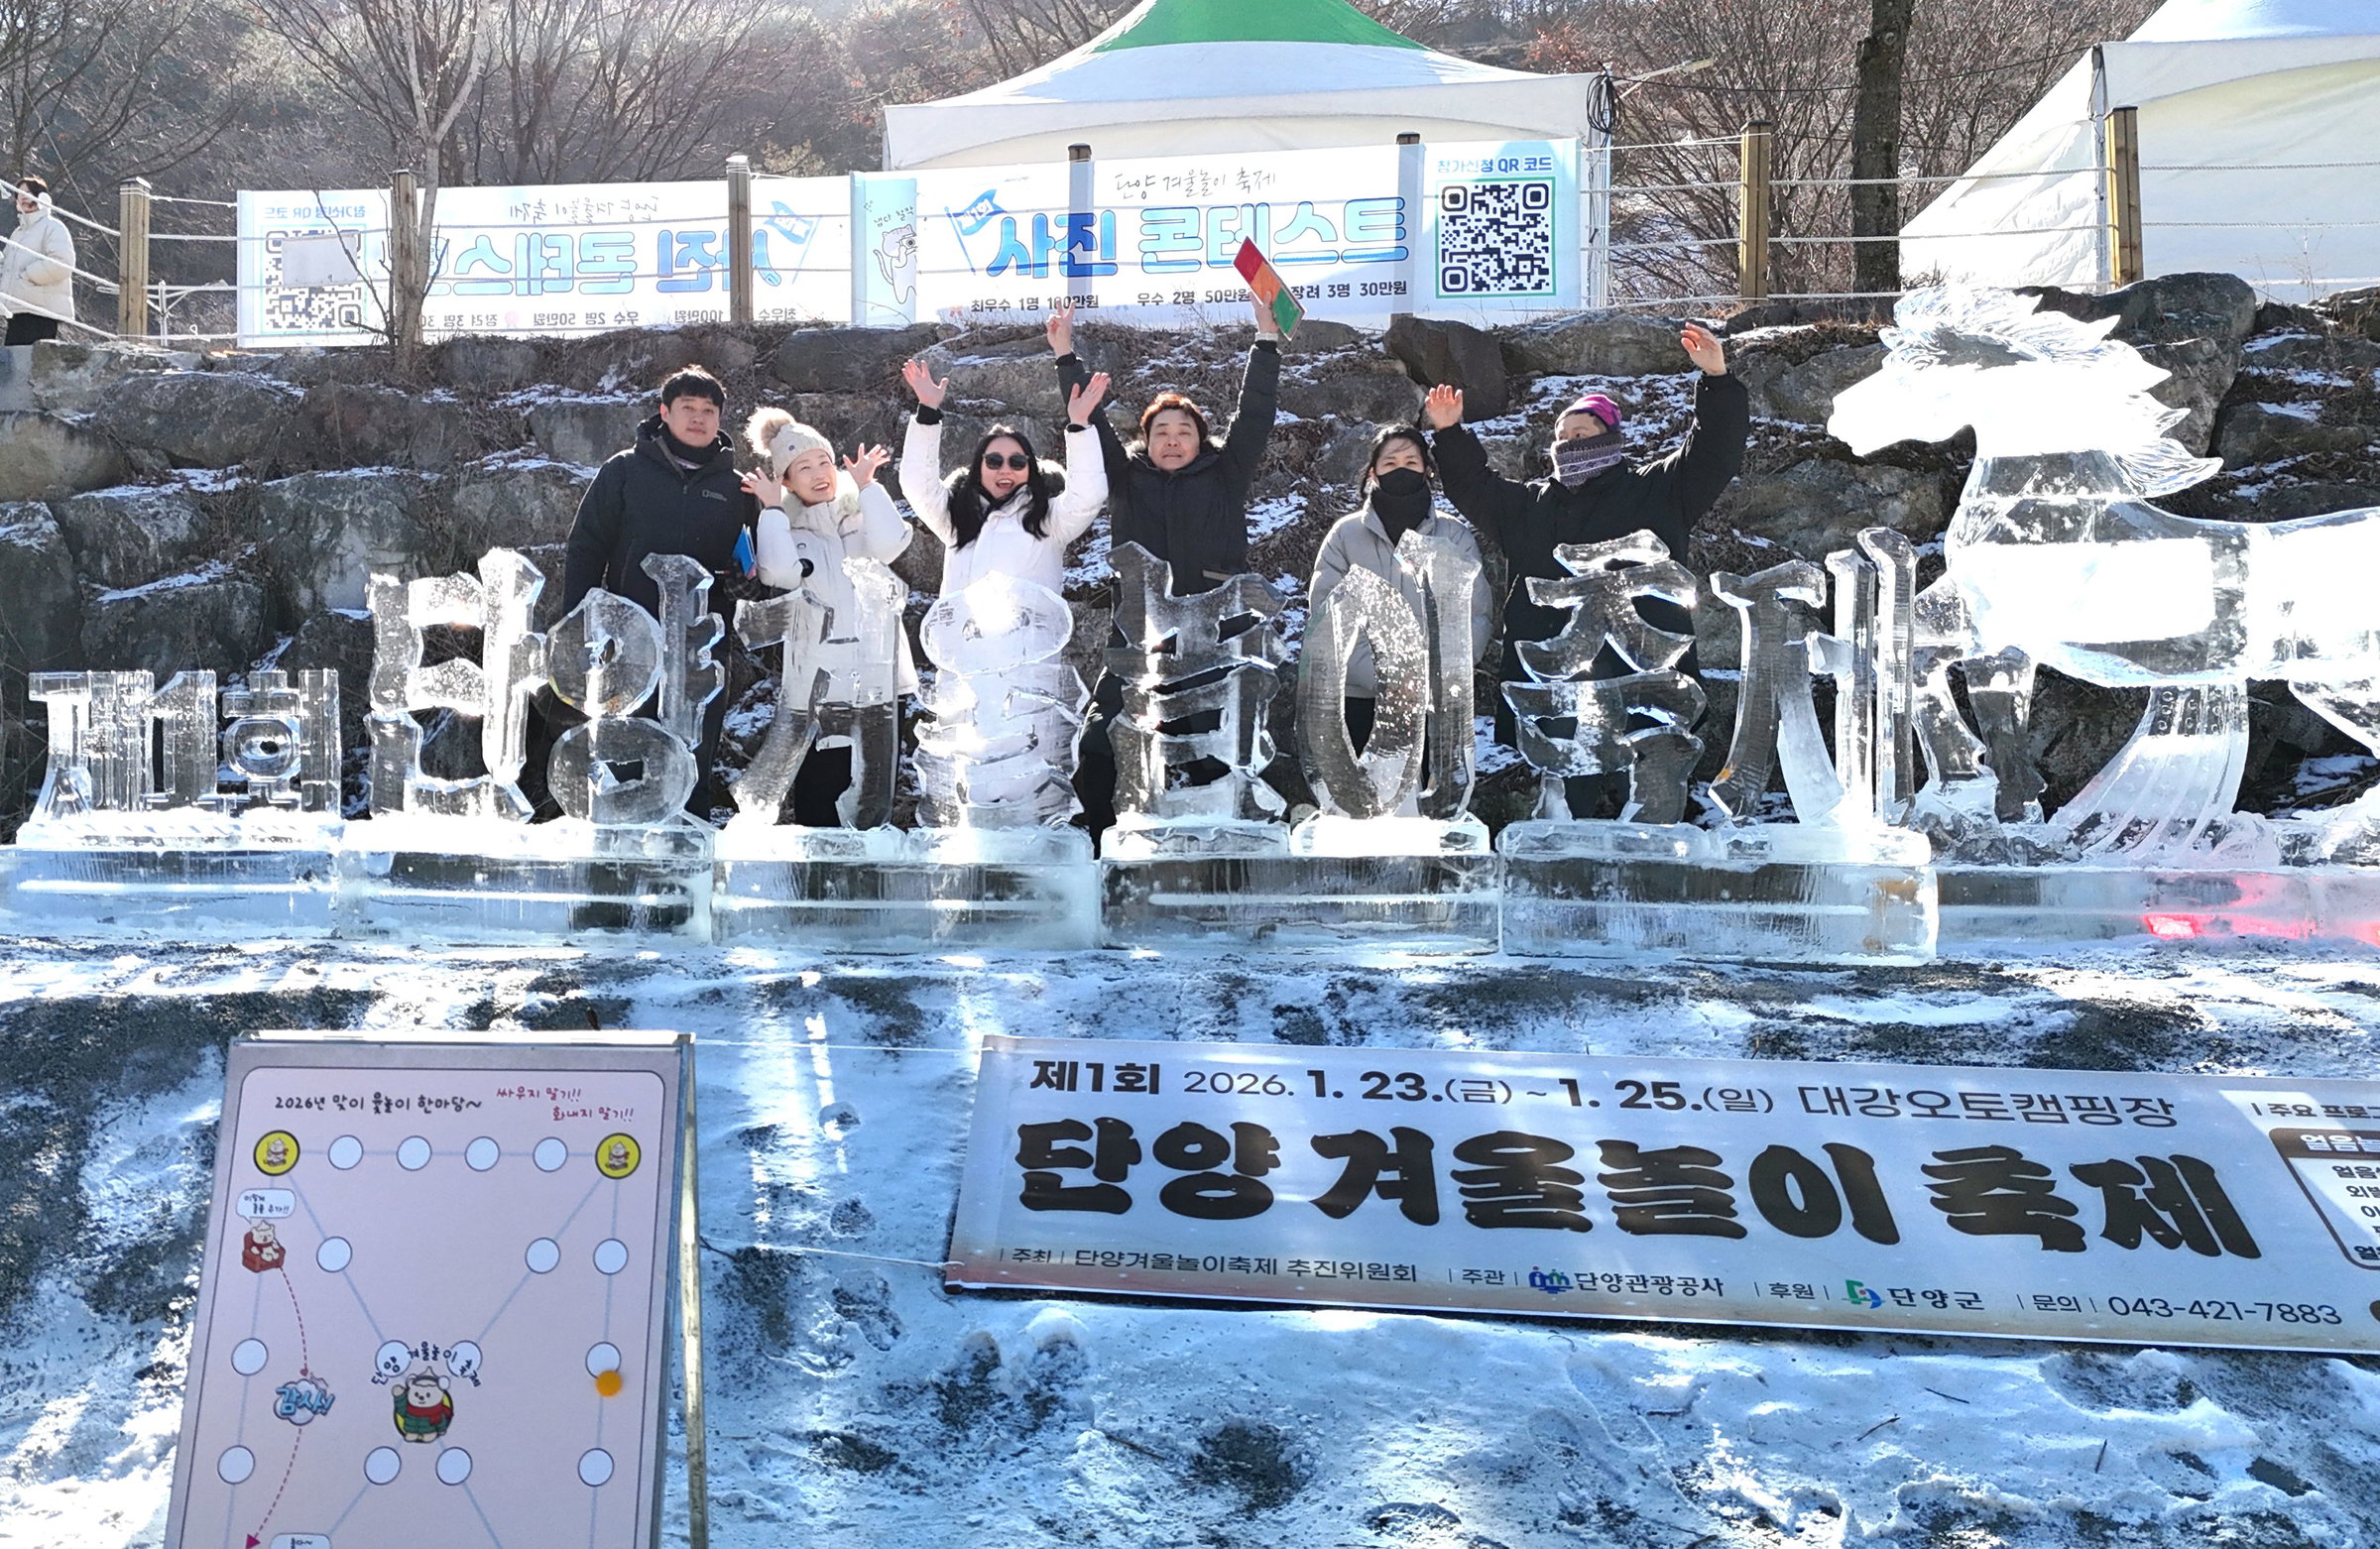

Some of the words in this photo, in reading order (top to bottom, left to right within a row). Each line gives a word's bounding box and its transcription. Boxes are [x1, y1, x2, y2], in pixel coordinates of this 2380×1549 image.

[1438, 158, 1493, 174] 참가신청
[1497, 158, 1519, 173] QR
[1523, 157, 1553, 172] 코드
[1114, 173, 1156, 199] 단양
[1162, 169, 1228, 197] 겨울놀이
[1236, 167, 1277, 194] 축제
[986, 209, 1119, 279] 사진
[1138, 196, 1409, 275] 콘테스트
[971, 298, 1011, 313] 최우수
[1019, 297, 1039, 311] 1명
[1047, 294, 1100, 310] 100만원
[1137, 293, 1163, 305] 우수
[1173, 291, 1196, 305] 2명
[1205, 289, 1251, 303] 50만원
[1291, 285, 1320, 300] 장려
[1327, 283, 1351, 298] 3명
[1360, 280, 1407, 297] 30만원
[274, 1096, 325, 1111] 2026년
[1029, 1059, 1160, 1096] 제1회
[1183, 1070, 1293, 1097] 2026.
[1798, 1085, 2180, 1130] 대강오토캠핑장
[2267, 1103, 2318, 1118] 주요
[1015, 1117, 1282, 1220] 단양
[1310, 1126, 1902, 1247] 겨울놀이
[1920, 1143, 2263, 1260] 축제
[1012, 1248, 1052, 1264] 주최
[1074, 1248, 1278, 1277] 단양겨울놀이축제
[1286, 1256, 1417, 1284] 추진위원회
[1461, 1267, 1505, 1286] 주관
[1574, 1271, 1724, 1298] 단양관광공사
[1768, 1281, 1815, 1302] 후원
[1886, 1286, 1985, 1311] 단양군
[2032, 1293, 2083, 1314] 문의
[2107, 1295, 2343, 1326] 043-421-7883
